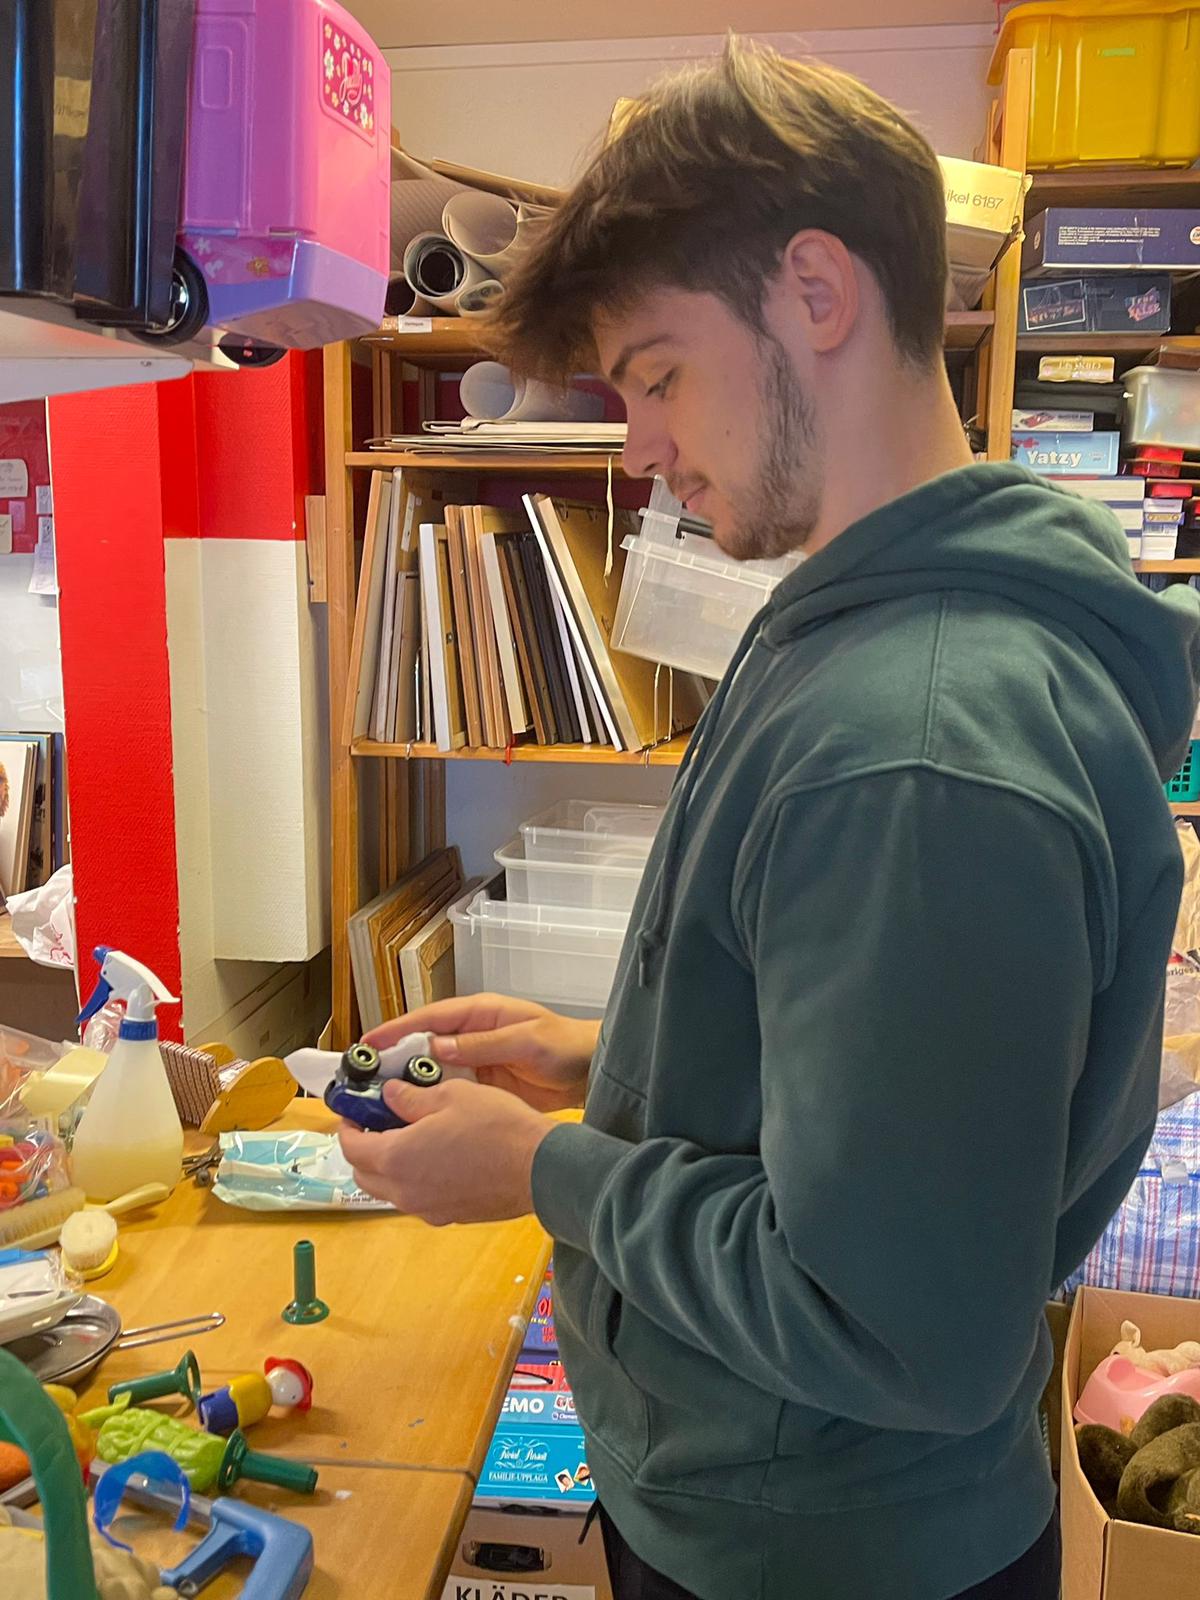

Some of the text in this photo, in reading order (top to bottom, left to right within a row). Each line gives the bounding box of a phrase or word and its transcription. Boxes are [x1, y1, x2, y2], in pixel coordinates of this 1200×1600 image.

[973, 194, 1004, 209] 6187
[1027, 450, 1081, 467] Yatzy
[456, 1585, 568, 1600] KLÄ
